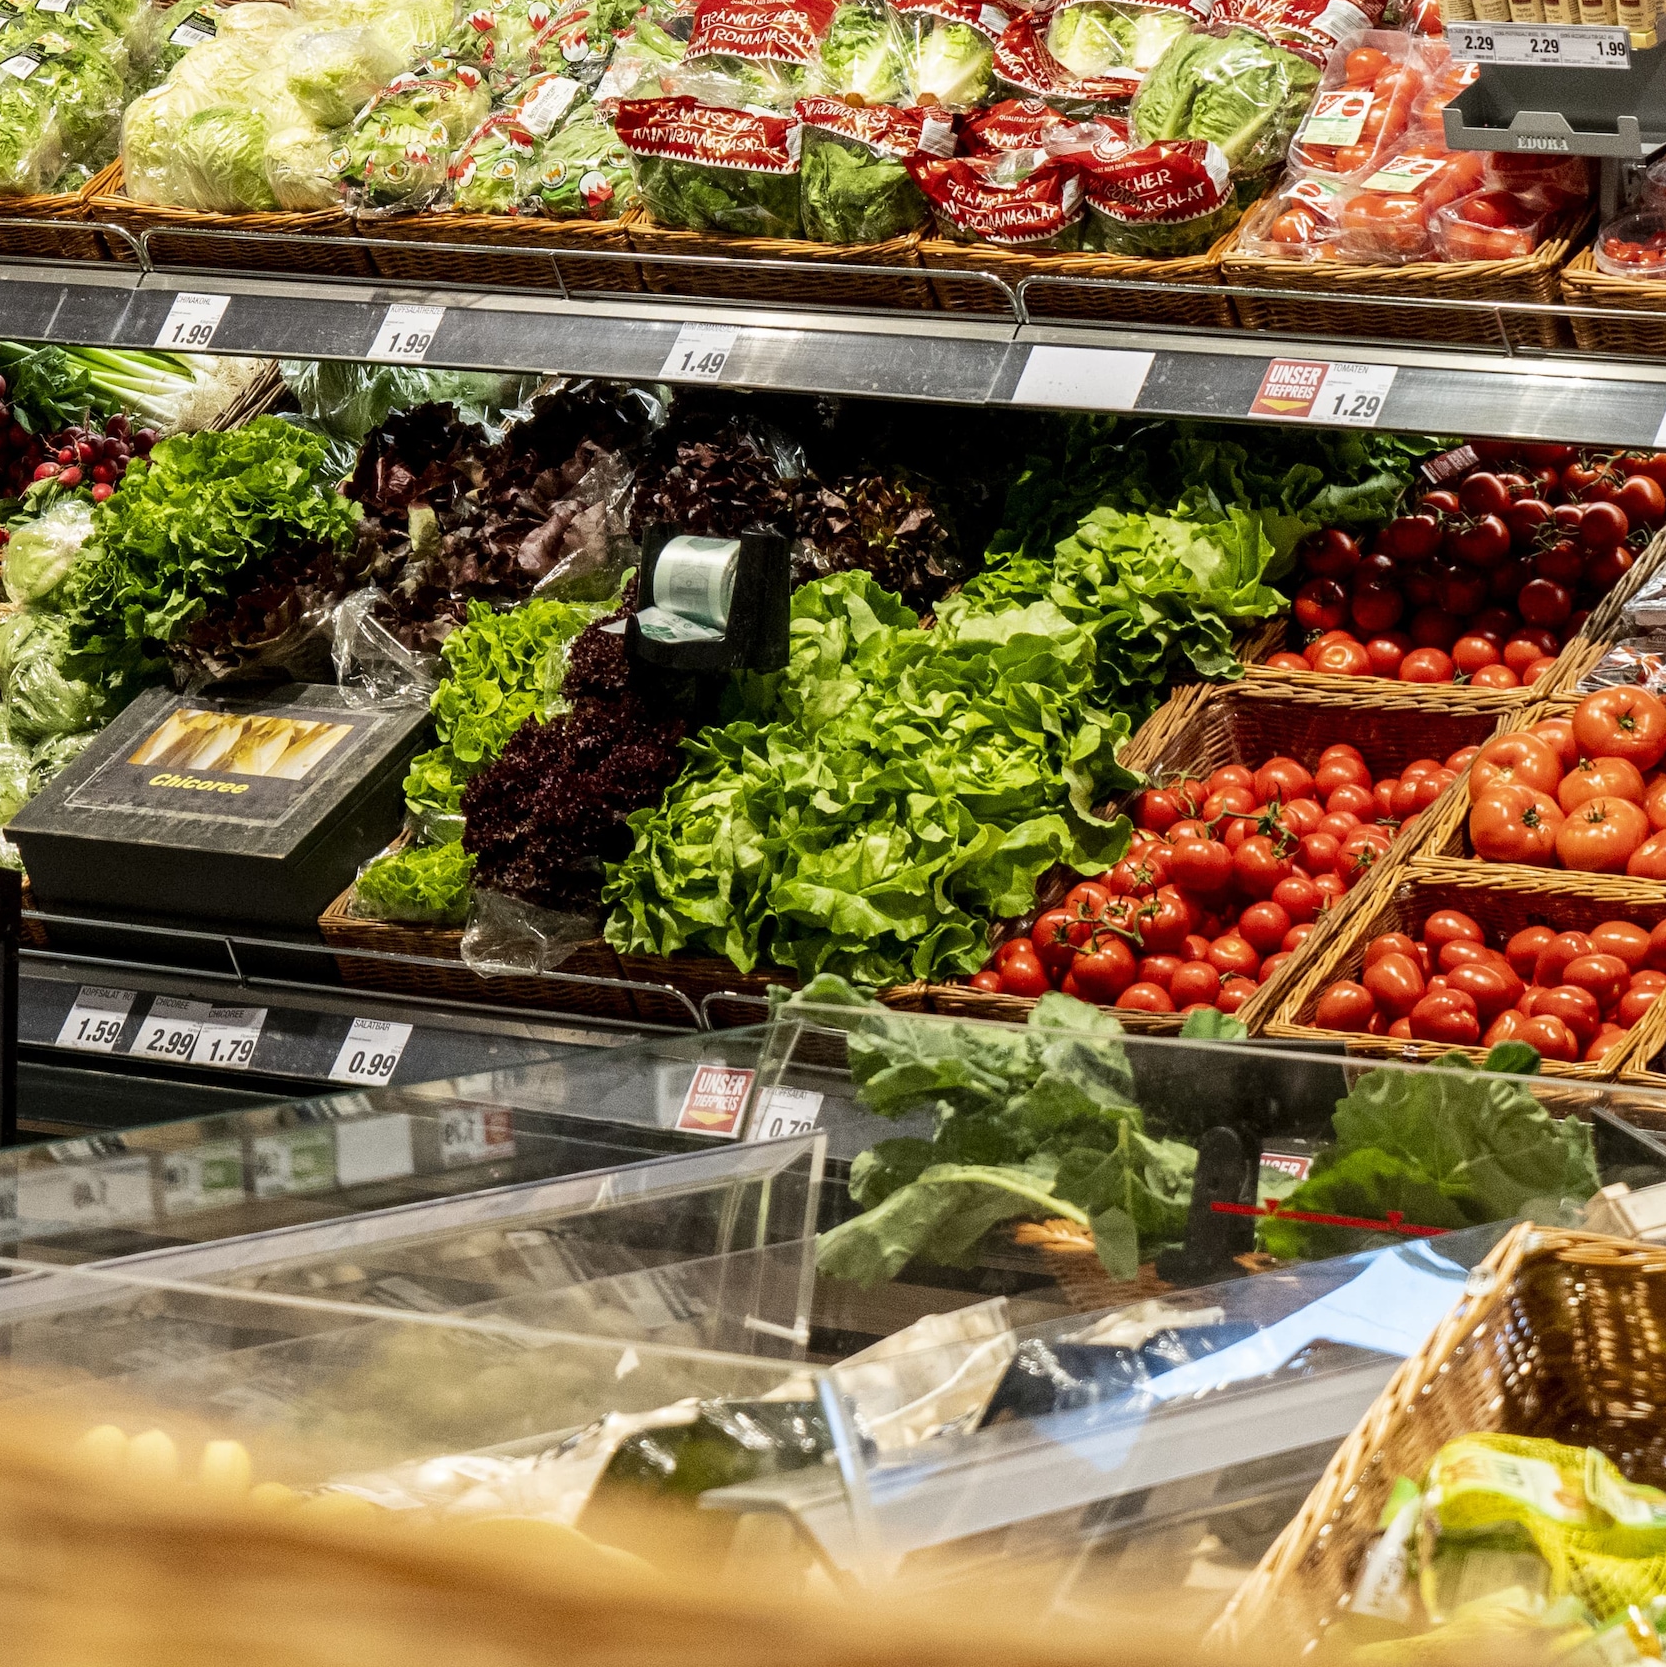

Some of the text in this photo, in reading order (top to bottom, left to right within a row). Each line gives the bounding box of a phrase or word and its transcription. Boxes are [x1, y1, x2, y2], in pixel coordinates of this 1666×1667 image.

[1464, 34, 1494, 51] 2.29
[1531, 38, 1559, 54] 2.29
[1596, 40, 1626, 57] 1.99
[176, 295, 211, 307] CHINAKOHL
[171, 322, 213, 346] 1.99
[386, 333, 431, 354] 1.99
[680, 350, 726, 374] 1.49
[1333, 363, 1369, 374] TOMATEN
[1269, 364, 1323, 385] UNSER
[1264, 383, 1315, 399] TIEFPREIS
[1332, 393, 1381, 418] 1.29
[147, 772, 250, 796] Chicoree
[82, 987, 120, 1000] KOPFSALAT
[155, 996, 190, 1010] CHICOREE
[208, 1007, 244, 1019] CHICOREE
[77, 1018, 120, 1043] 1.59
[353, 1019, 391, 1032] SALATBAR
[146, 1029, 194, 1055] 2.99
[210, 1038, 254, 1063] 1.79
[348, 1050, 396, 1077] 0.99
[697, 1072, 747, 1096] UNSER
[692, 1094, 740, 1111] TIEFPREIS
